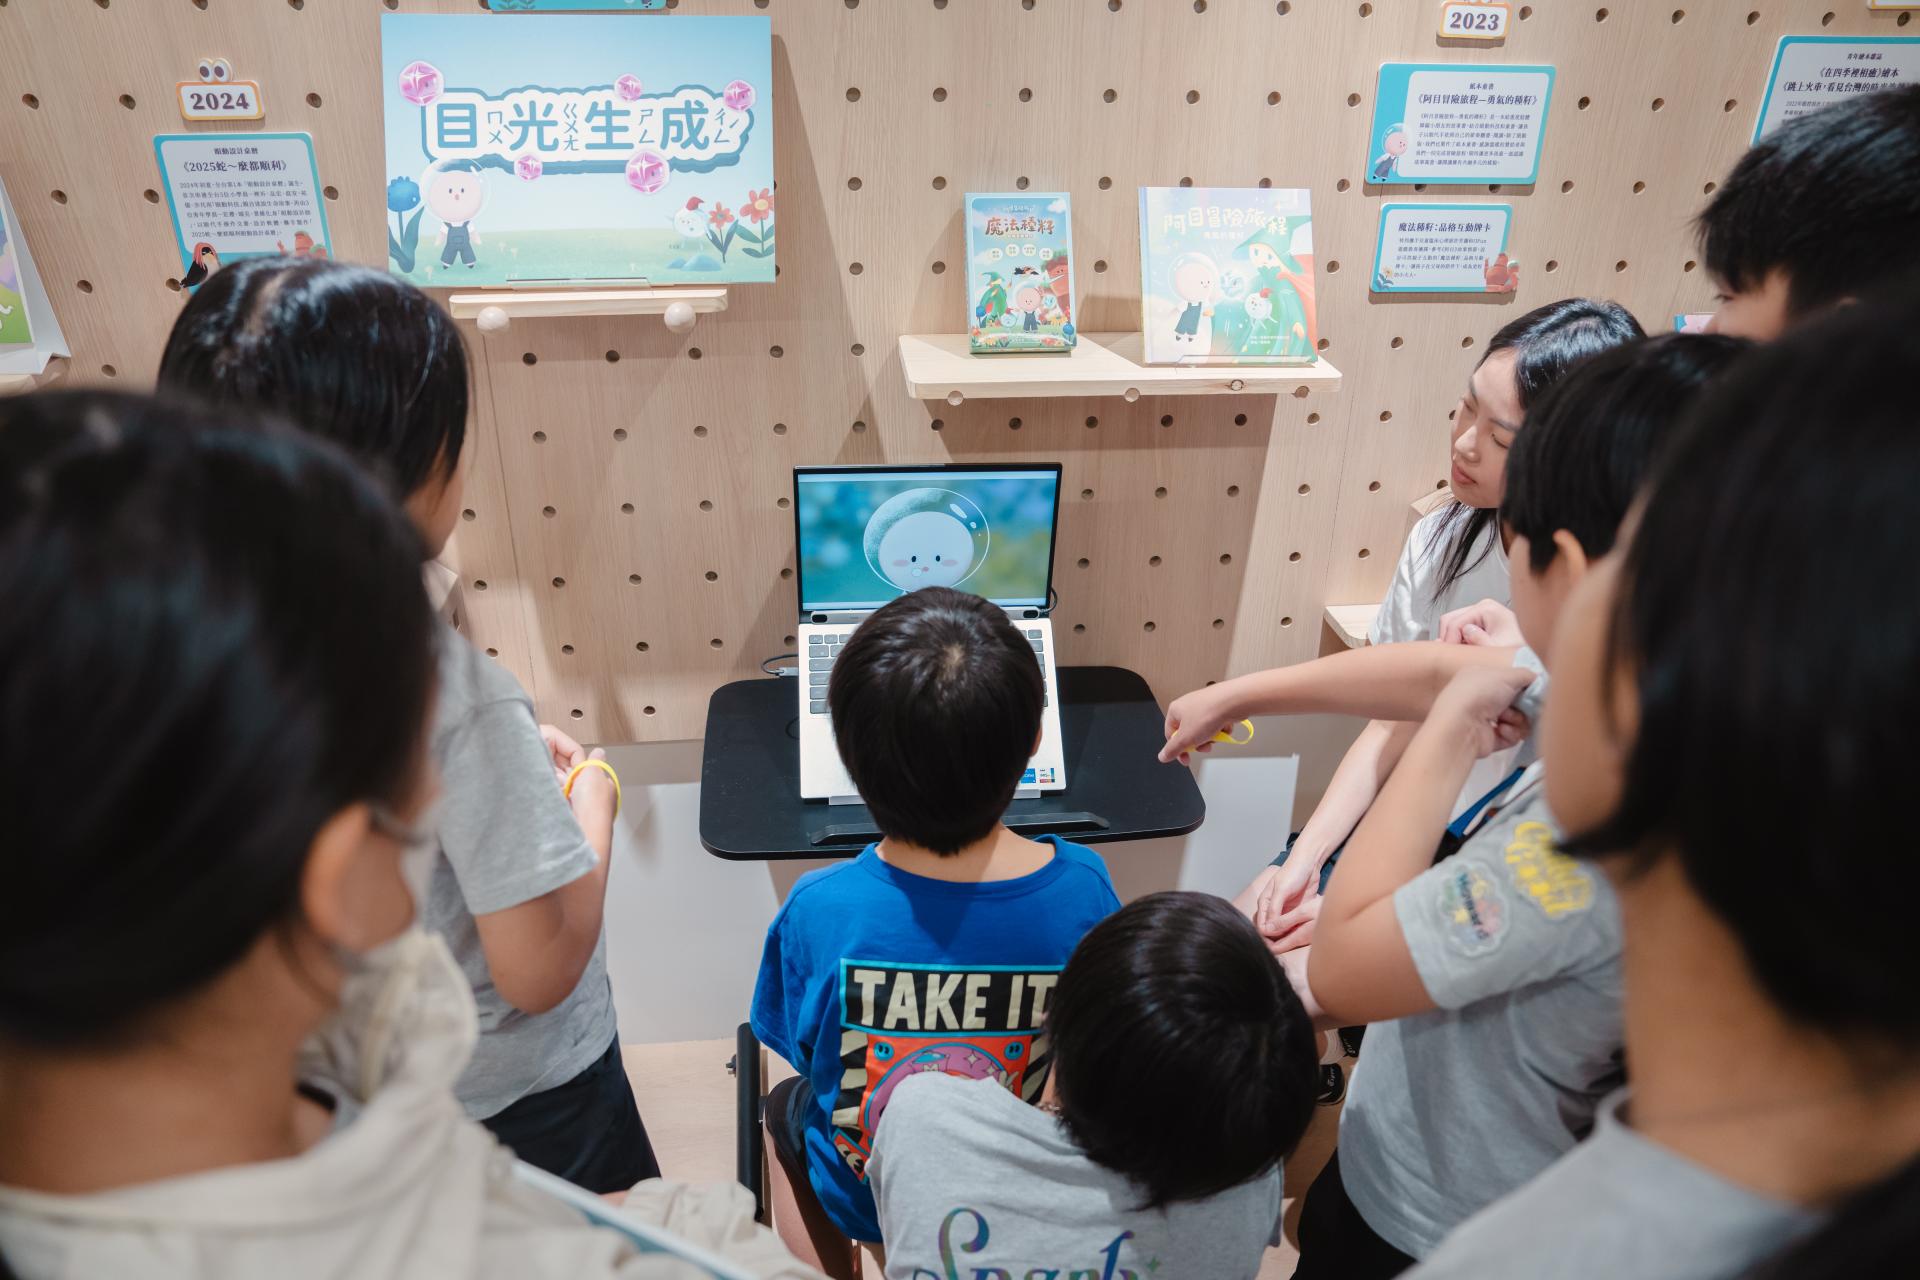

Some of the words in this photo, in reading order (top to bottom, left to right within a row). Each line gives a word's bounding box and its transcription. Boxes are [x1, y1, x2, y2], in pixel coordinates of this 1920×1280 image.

[1449, 12, 1500, 31] 2023
[189, 92, 250, 111] 2024
[985, 216, 1055, 236] 魔法種籽
[853, 968, 992, 1031] TAKE
[1006, 973, 1060, 1030] IT
